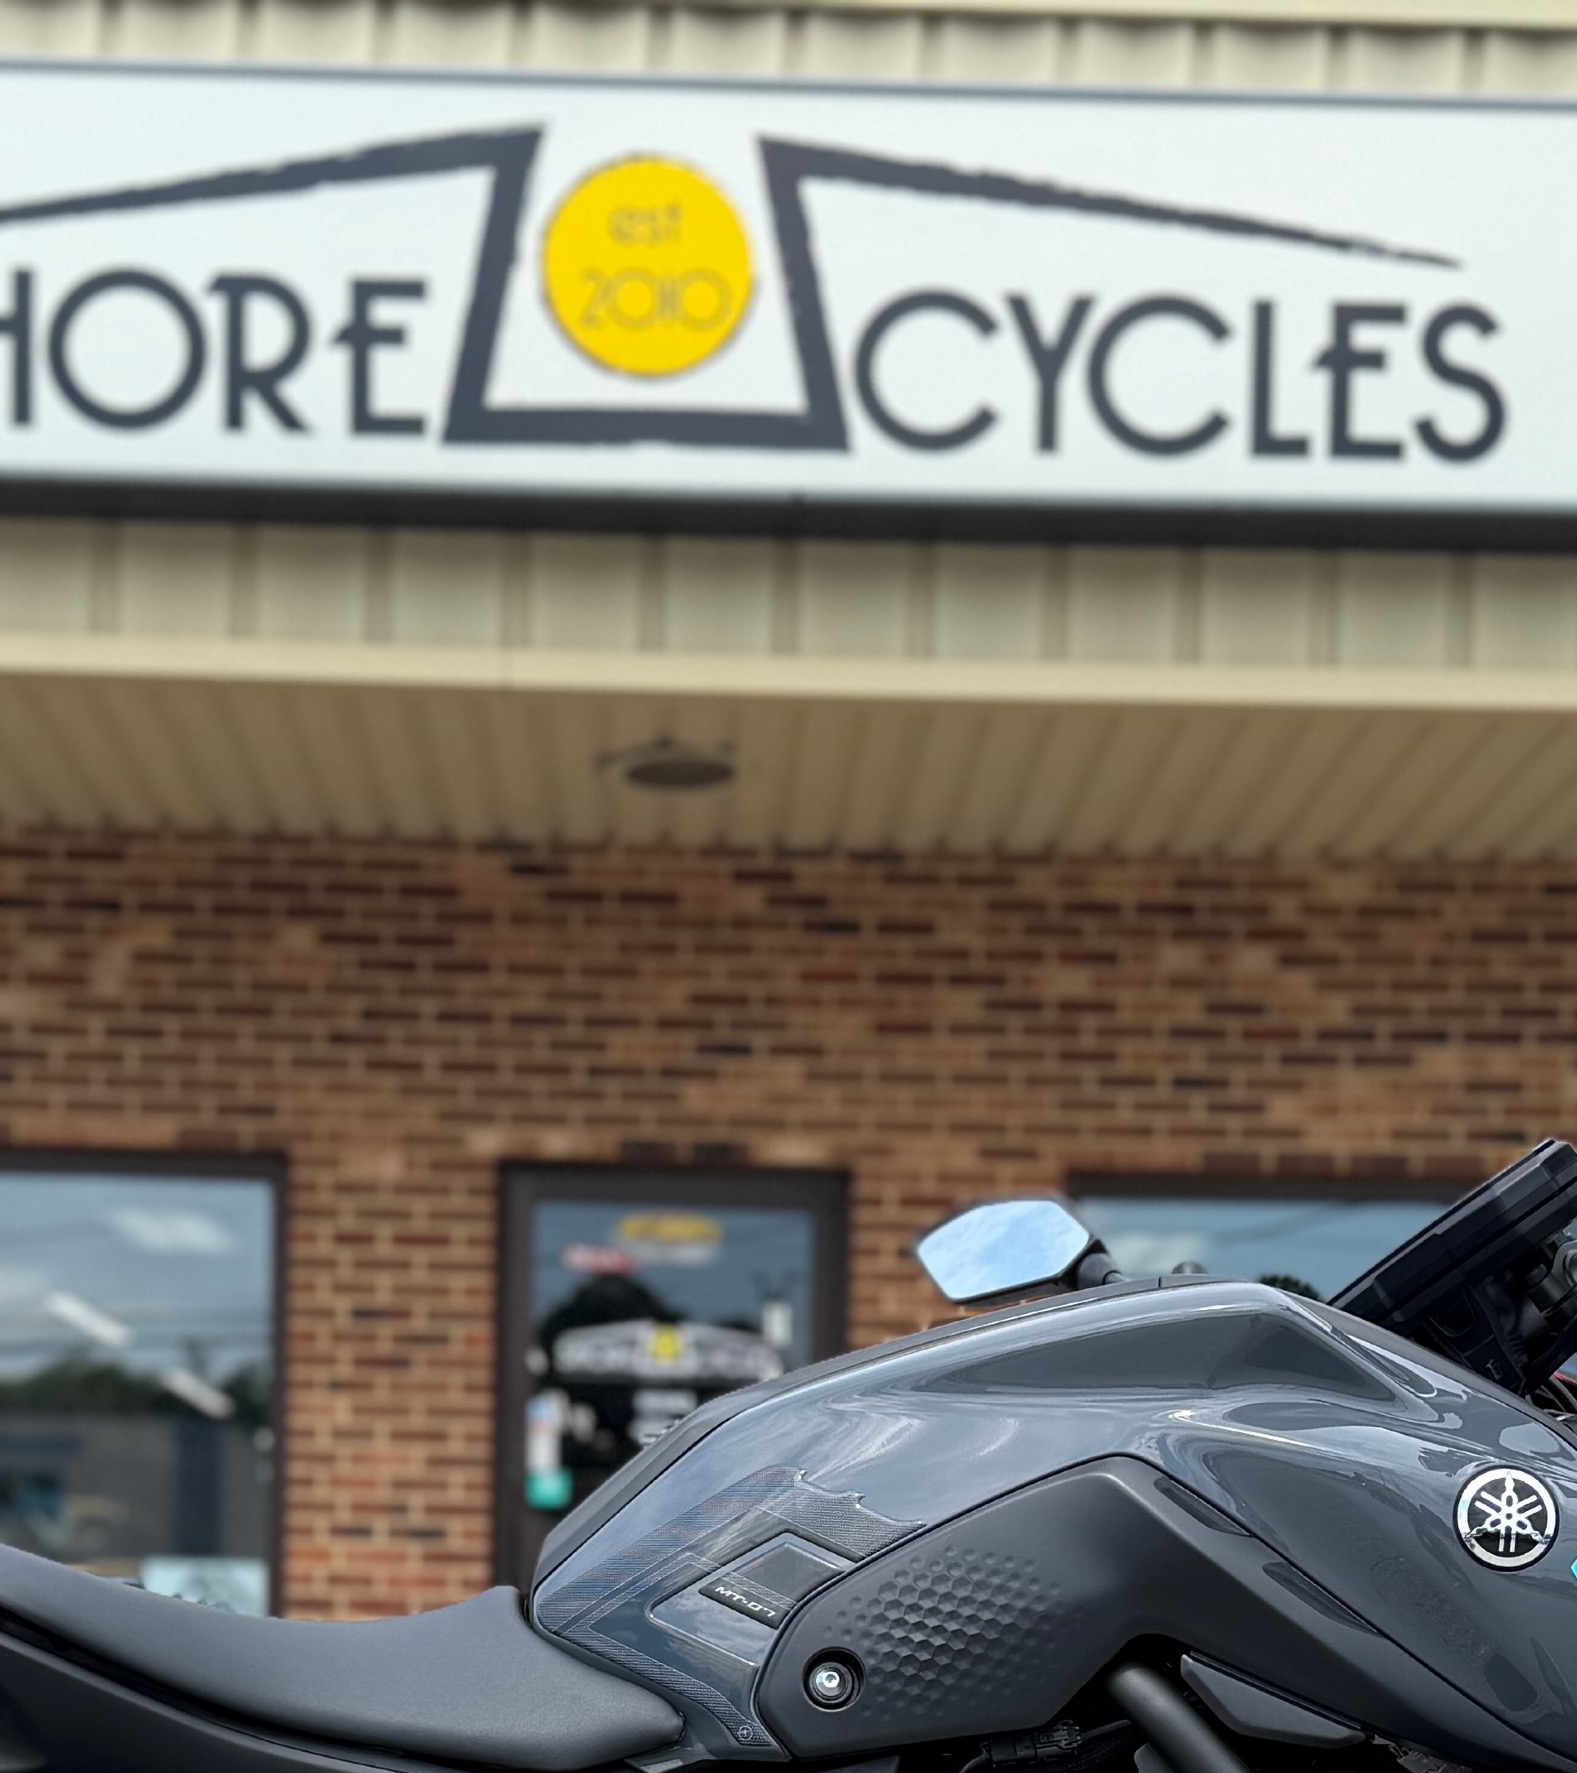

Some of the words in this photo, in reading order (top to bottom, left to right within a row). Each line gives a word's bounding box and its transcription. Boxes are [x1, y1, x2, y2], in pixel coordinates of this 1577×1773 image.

[608, 200, 682, 246] est
[577, 266, 732, 331] 2010
[854, 288, 1506, 462] CYCLES
[714, 1586, 776, 1618] MT-07
